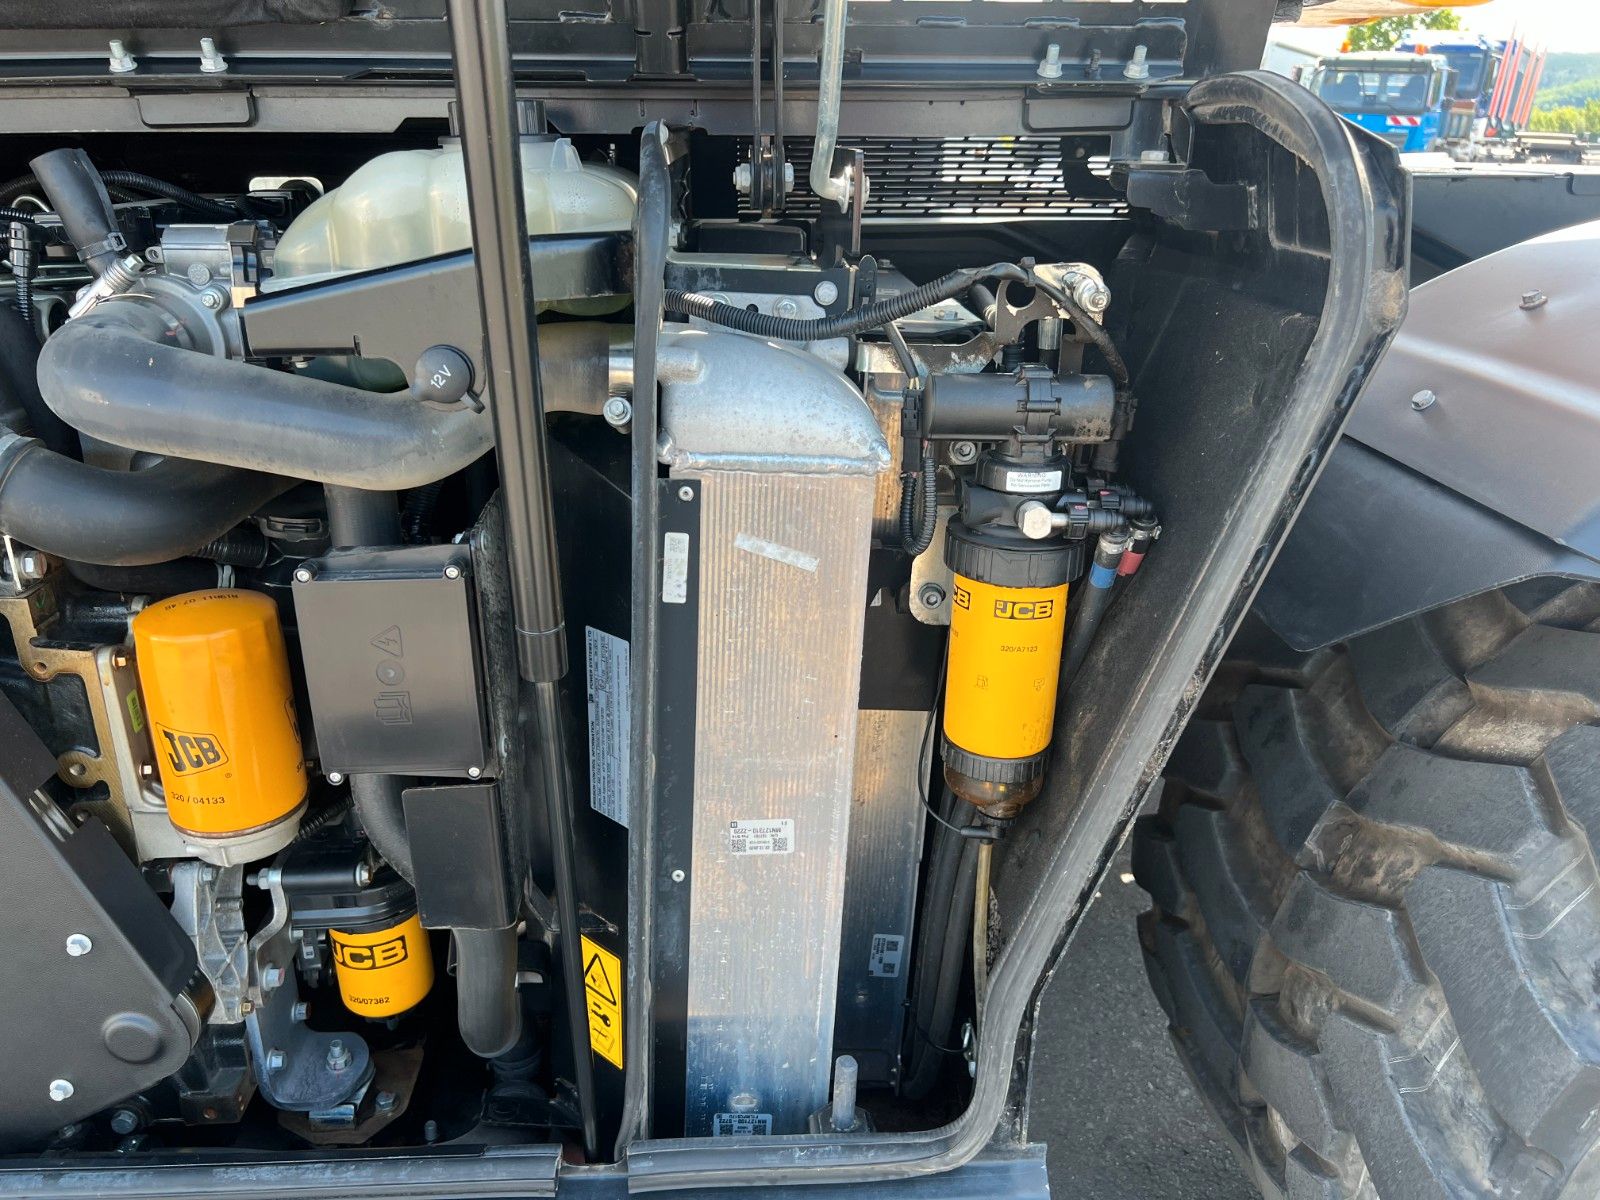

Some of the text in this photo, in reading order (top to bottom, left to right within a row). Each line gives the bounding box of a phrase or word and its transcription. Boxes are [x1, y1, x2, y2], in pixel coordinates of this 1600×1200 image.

[430, 364, 452, 389] 12V
[995, 601, 1053, 620] JCB
[1000, 645, 1038, 653] 320/A7123
[162, 729, 222, 772] JCB
[333, 938, 406, 969] JCB
